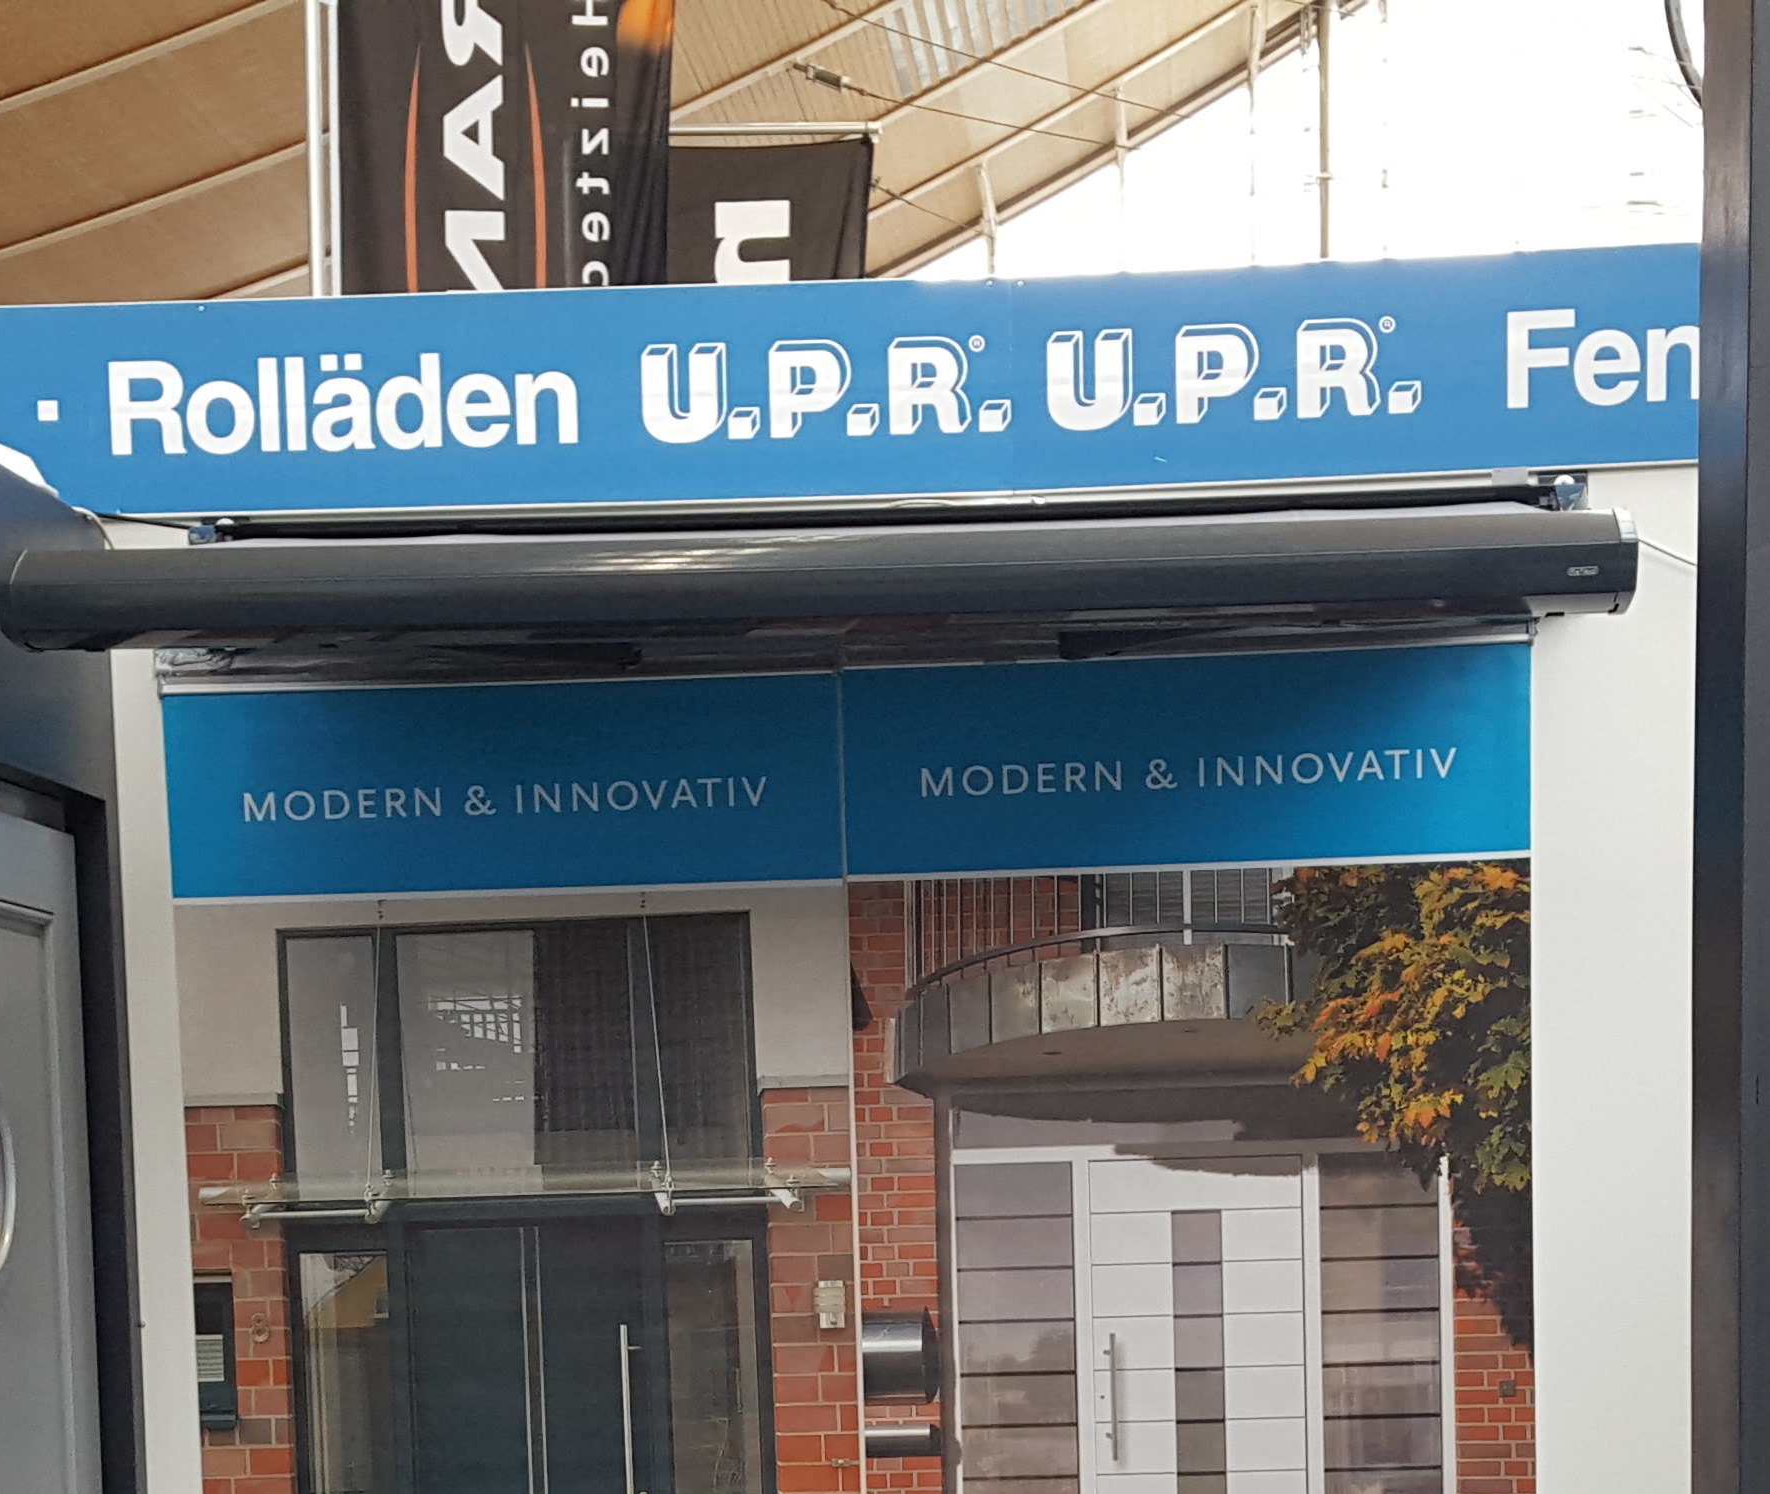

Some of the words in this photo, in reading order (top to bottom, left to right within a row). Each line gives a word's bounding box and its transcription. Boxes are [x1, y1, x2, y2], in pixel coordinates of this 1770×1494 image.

[108, 353, 578, 455] Rolläden
[921, 761, 1122, 798] MODERN
[1145, 758, 1177, 790] &
[1198, 747, 1457, 788] INNOVATIV
[243, 787, 442, 823] MODERN
[464, 785, 496, 816] &
[516, 776, 767, 813] INNOVATIV
